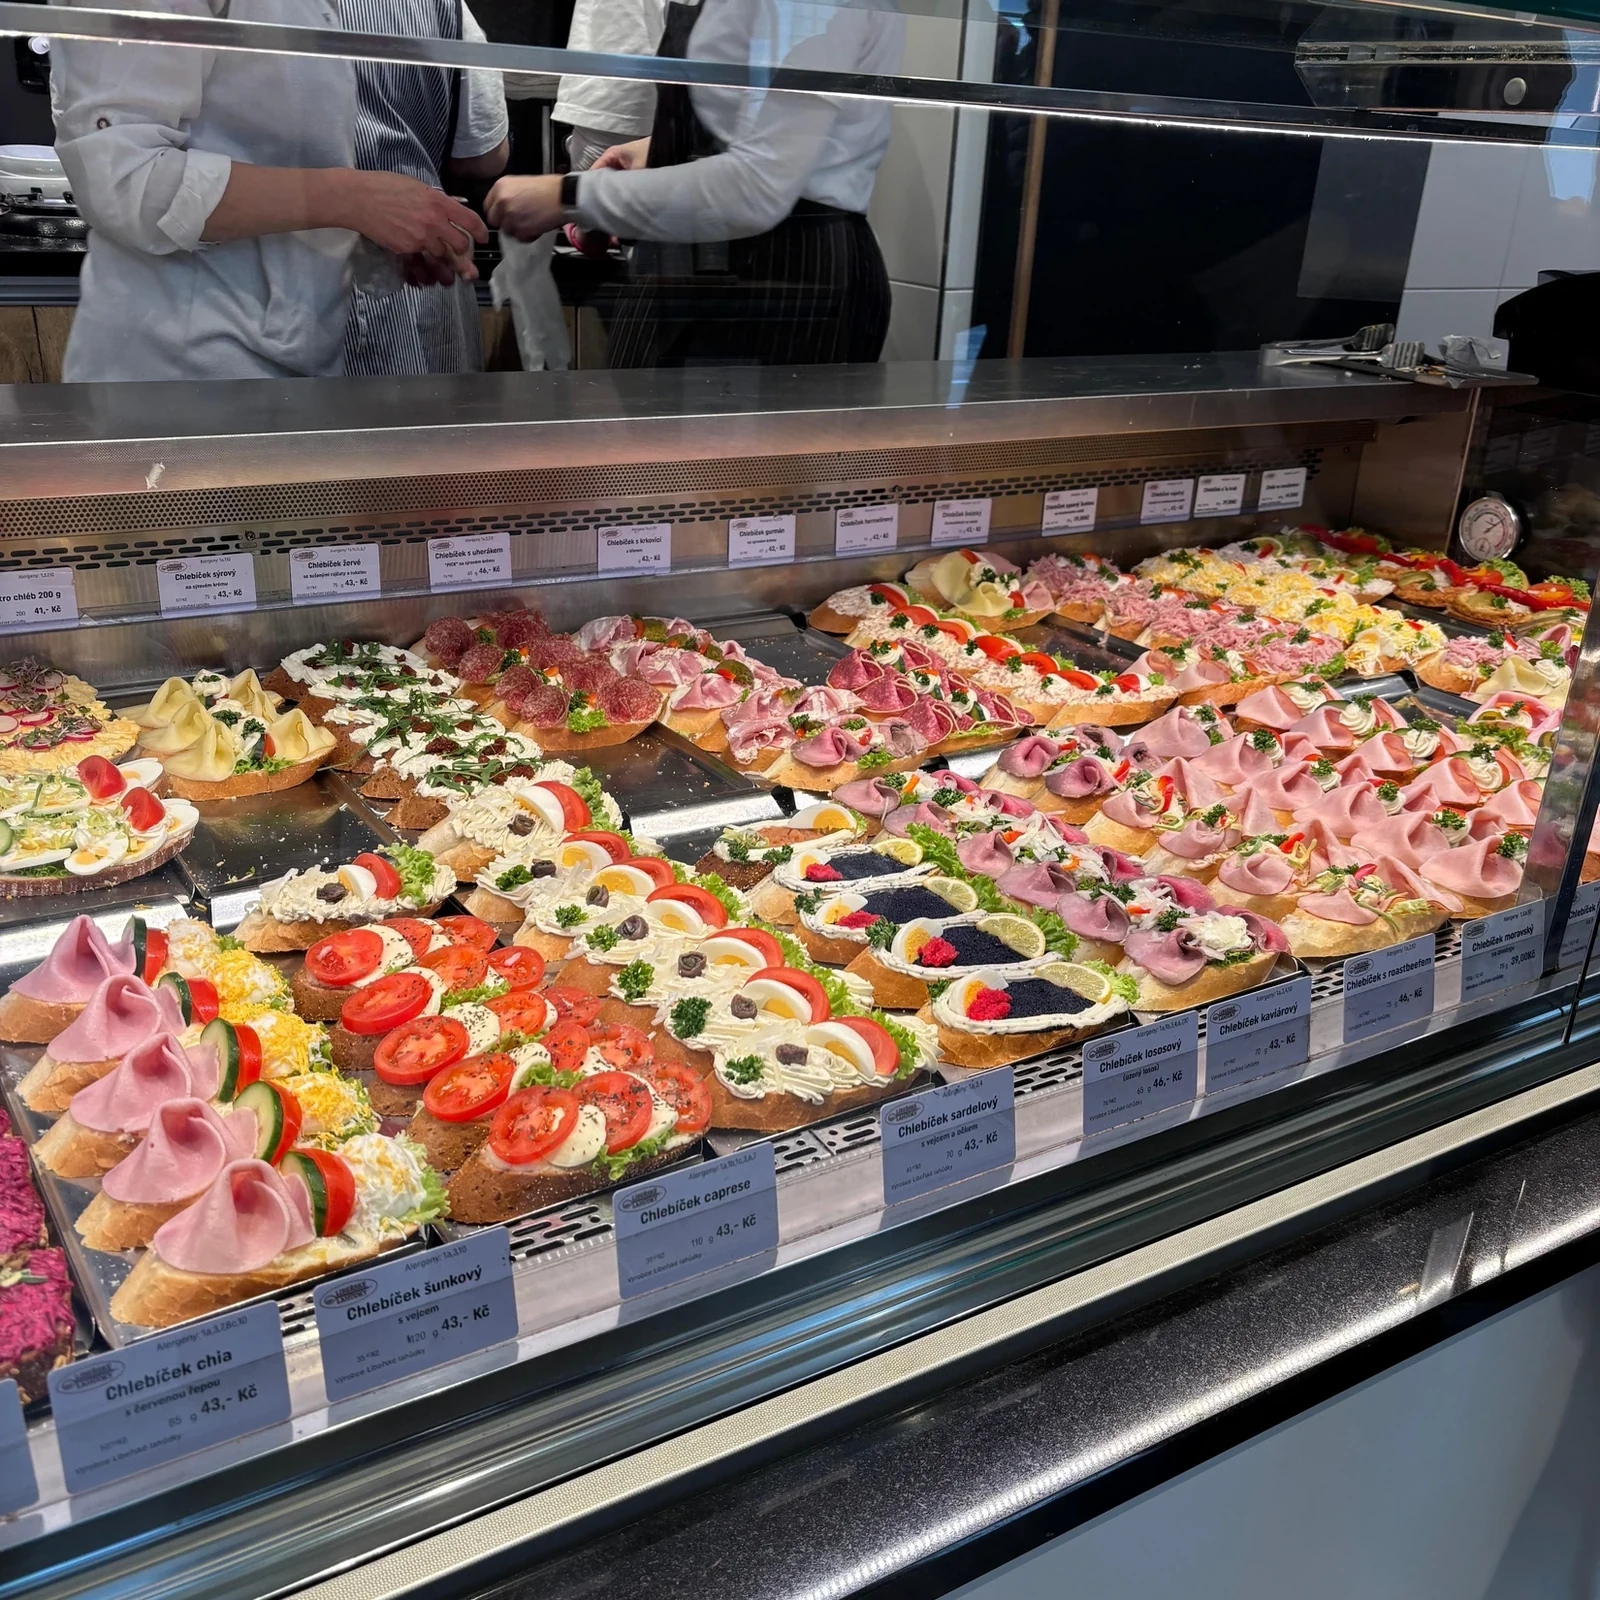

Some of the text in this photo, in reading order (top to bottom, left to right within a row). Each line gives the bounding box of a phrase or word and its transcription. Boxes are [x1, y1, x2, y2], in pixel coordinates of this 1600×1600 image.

[607, 537, 635, 546] Chlebíček
[435, 550, 466, 560] Chlebíček
[472, 547, 504, 556] uherákem
[653, 553, 661, 561] Kč
[308, 559, 361, 569] Chlebíček žervé
[479, 567, 492, 575] 46,-
[492, 565, 501, 573] Kč
[175, 568, 237, 581] Chlebíček sýrový
[345, 579, 358, 587] 43,-
[359, 577, 368, 585] Kč
[13, 590, 61, 601] chléb 200 g
[192, 582, 212, 590] sýrovém
[217, 590, 232, 598] 43,-
[233, 588, 243, 596] Kč
[34, 606, 49, 615] 41,-
[51, 604, 62, 613] Kč
[1472, 935, 1503, 952] Chlebíček
[1504, 924, 1534, 942] moravský
[1511, 949, 1536, 965] 39,00Kč
[1346, 972, 1382, 991] Chlebíček
[1382, 972, 1387, 980] s
[1388, 957, 1432, 978] roastbeefem
[1399, 993, 1413, 1003] 46,-
[1414, 986, 1423, 998] Kč
[1220, 1002, 1299, 1035] Chlebíček kaviárový
[1269, 1039, 1285, 1050] 43,-
[1286, 1032, 1296, 1045] Kč
[1100, 1038, 1182, 1073] Chlebíček lososový
[1122, 1063, 1160, 1082] (uzený losos)
[1136, 1086, 1144, 1095] 65
[1153, 1076, 1170, 1088] 46,-
[1172, 1070, 1183, 1082] Kč
[898, 1095, 999, 1138] Chlebíček sardelový
[926, 1133, 951, 1146] vejcem
[945, 1130, 998, 1159] 70 g 43,- Kč
[640, 1179, 751, 1225] Chlebíček caprese
[690, 1213, 757, 1247] 110 g 43,- Kč
[405, 1254, 442, 1272] Alergeny:
[347, 1264, 483, 1321] Chlebíček šunkový
[398, 1305, 440, 1325] s vejcem
[432, 1330, 439, 1340] g
[441, 1314, 468, 1331] 43,-
[473, 1304, 491, 1321] Kč
[156, 1332, 200, 1352] Alergeny:
[106, 1351, 233, 1401] Chlebíček chia
[125, 1379, 221, 1417] s červenou řepou
[190, 1413, 198, 1423] g
[201, 1397, 233, 1415] 43,-
[237, 1383, 259, 1403] Kč
